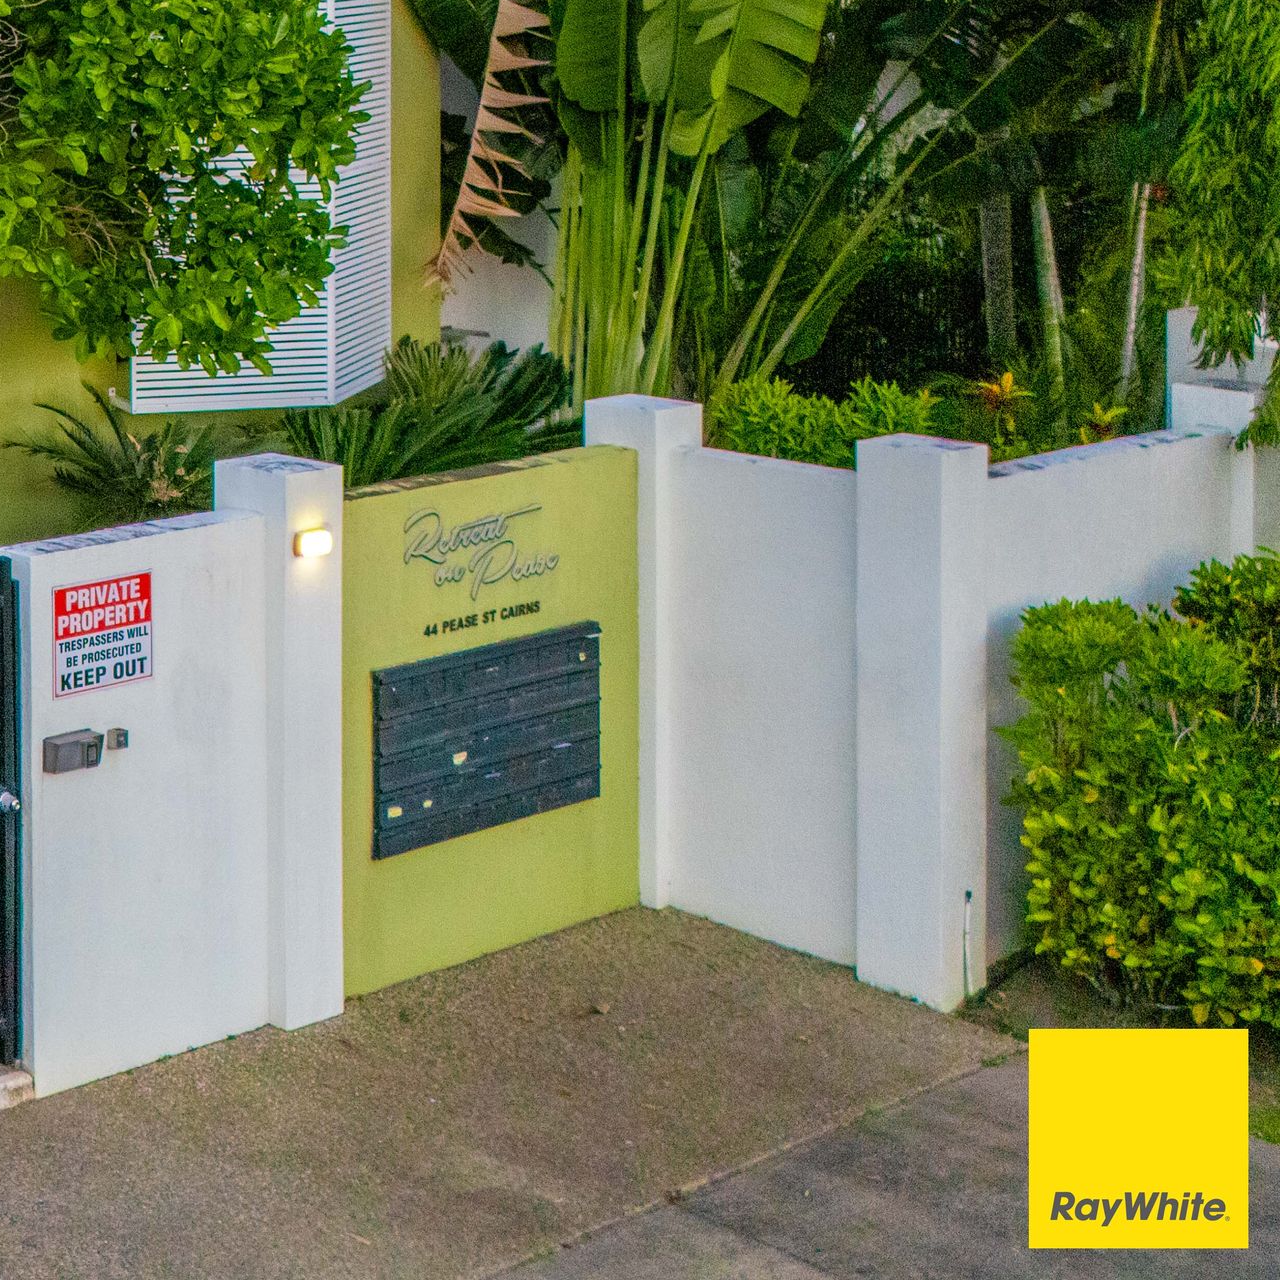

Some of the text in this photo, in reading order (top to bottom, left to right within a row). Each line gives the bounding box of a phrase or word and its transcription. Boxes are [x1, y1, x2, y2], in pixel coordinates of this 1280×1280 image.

[404, 503, 543, 564] Retreat
[468, 540, 560, 601] Pease
[66, 578, 140, 612] PRIVATE
[58, 599, 148, 637] PROPERTY
[423, 600, 540, 637] 44 PEASE ST CAIRNS
[59, 625, 149, 654] TRESPASSERS WILL
[66, 642, 142, 668] BE PROSECUTED
[61, 656, 148, 691] KEEP OUT
